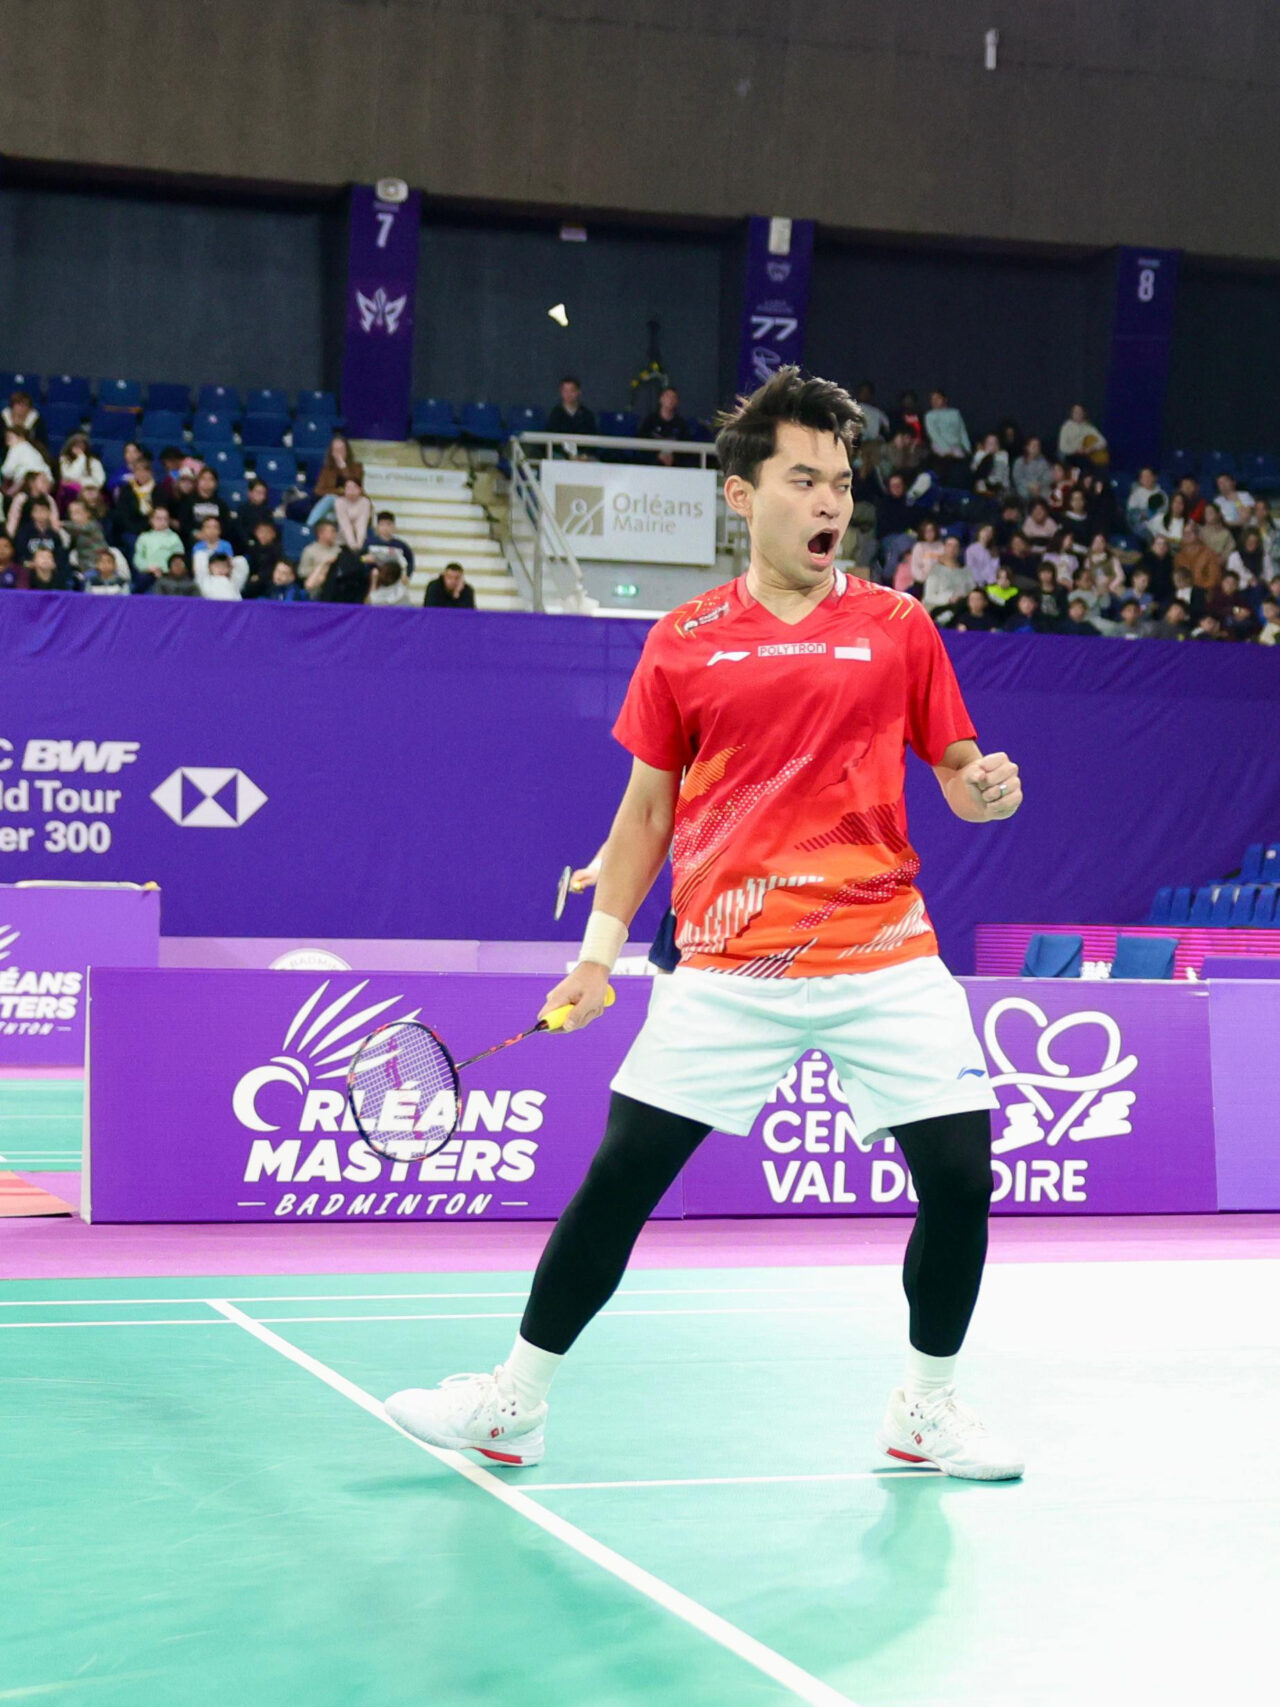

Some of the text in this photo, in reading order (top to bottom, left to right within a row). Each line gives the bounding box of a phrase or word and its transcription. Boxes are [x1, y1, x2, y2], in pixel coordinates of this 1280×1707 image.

[376, 212, 395, 248] 7
[1139, 269, 1155, 302] 8
[751, 314, 798, 341] 77
[612, 492, 704, 518] Orléans
[614, 514, 677, 534] Mairie
[759, 643, 825, 656] POLYTRON
[21, 738, 141, 774] BWF
[34, 779, 122, 814] Tour
[44, 820, 112, 854] 300
[243, 1139, 539, 1182] MASTERS
[761, 1160, 857, 1203] VAL
[274, 1192, 493, 1217] BADMINTON
